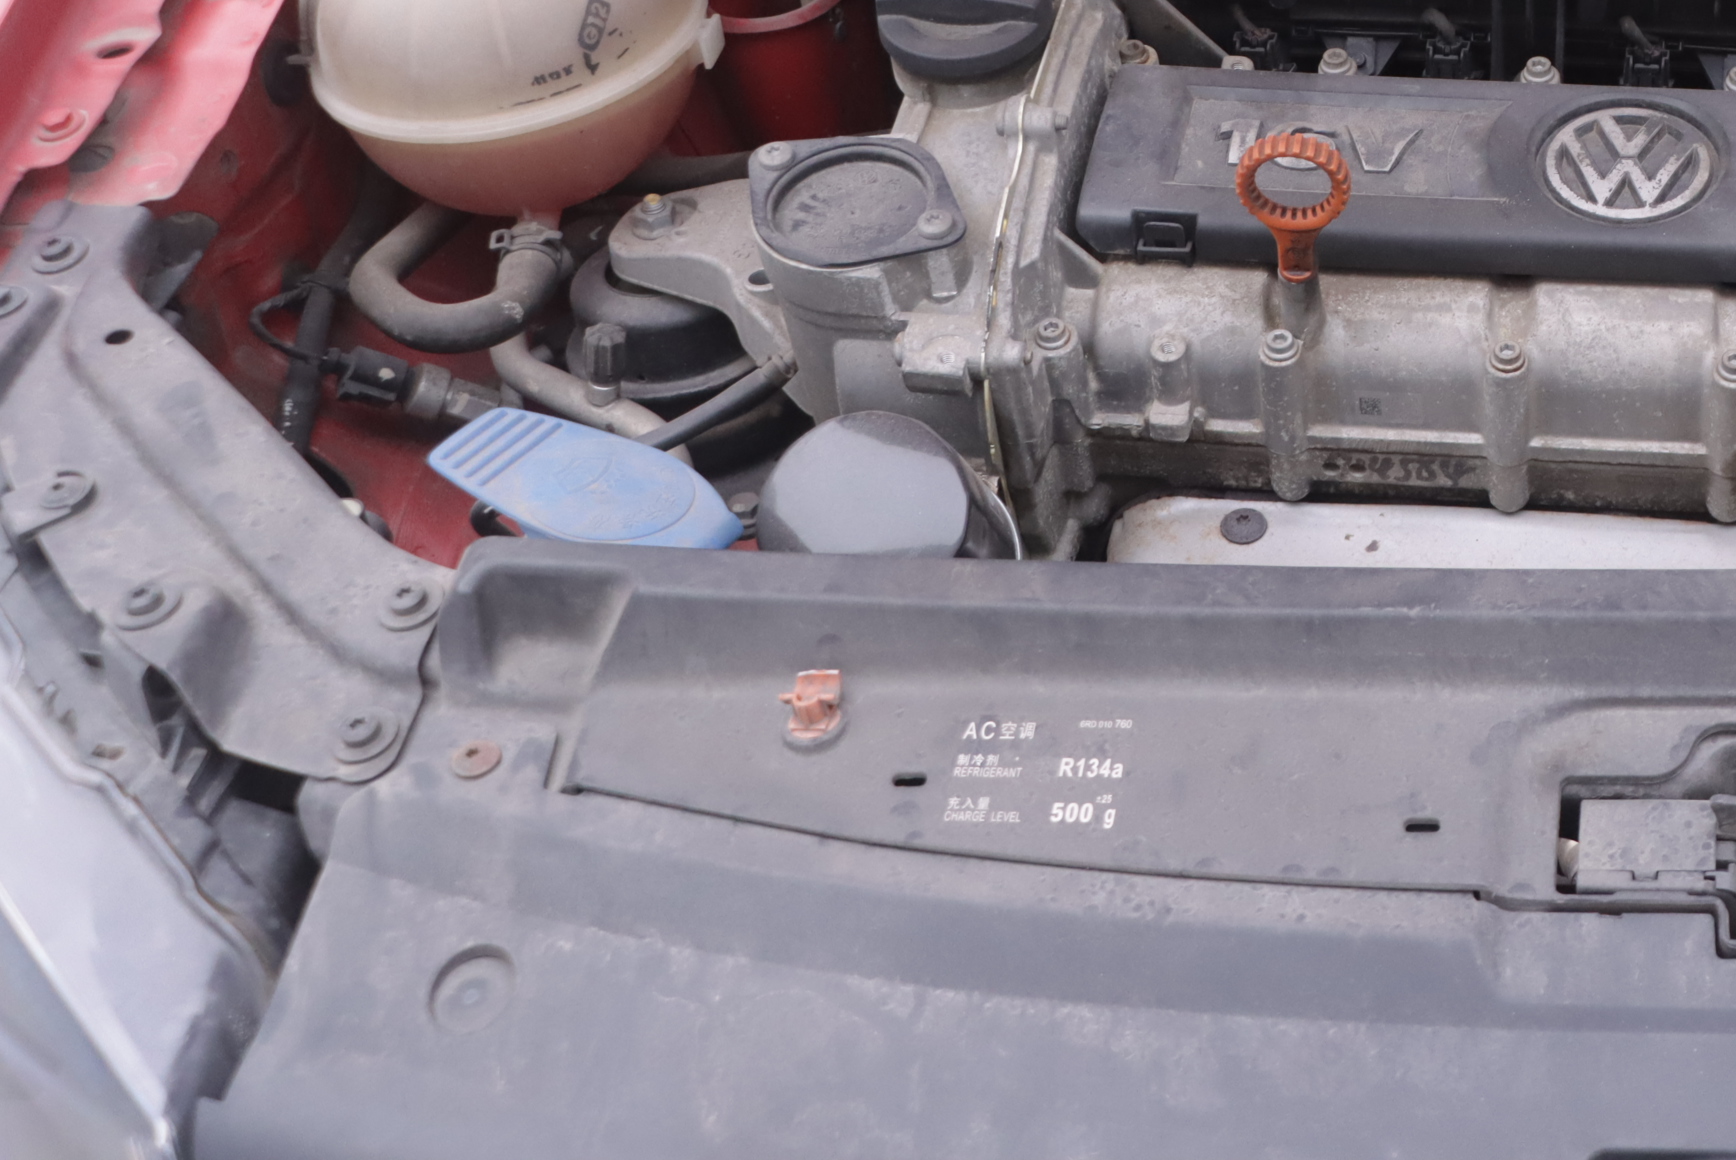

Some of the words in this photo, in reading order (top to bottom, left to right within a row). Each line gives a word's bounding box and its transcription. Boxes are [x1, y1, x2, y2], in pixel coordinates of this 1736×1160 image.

[1115, 719, 1133, 729] 760
[956, 754, 999, 766] 制冷剂
[954, 766, 1023, 778] REFRIGERANT
[1058, 757, 1124, 778] R134a
[947, 797, 990, 810] 充入量
[944, 811, 985, 822] CHARGE
[990, 812, 1020, 822] LEVEL
[1050, 802, 1094, 823] 500
[1103, 808, 1116, 829] g
